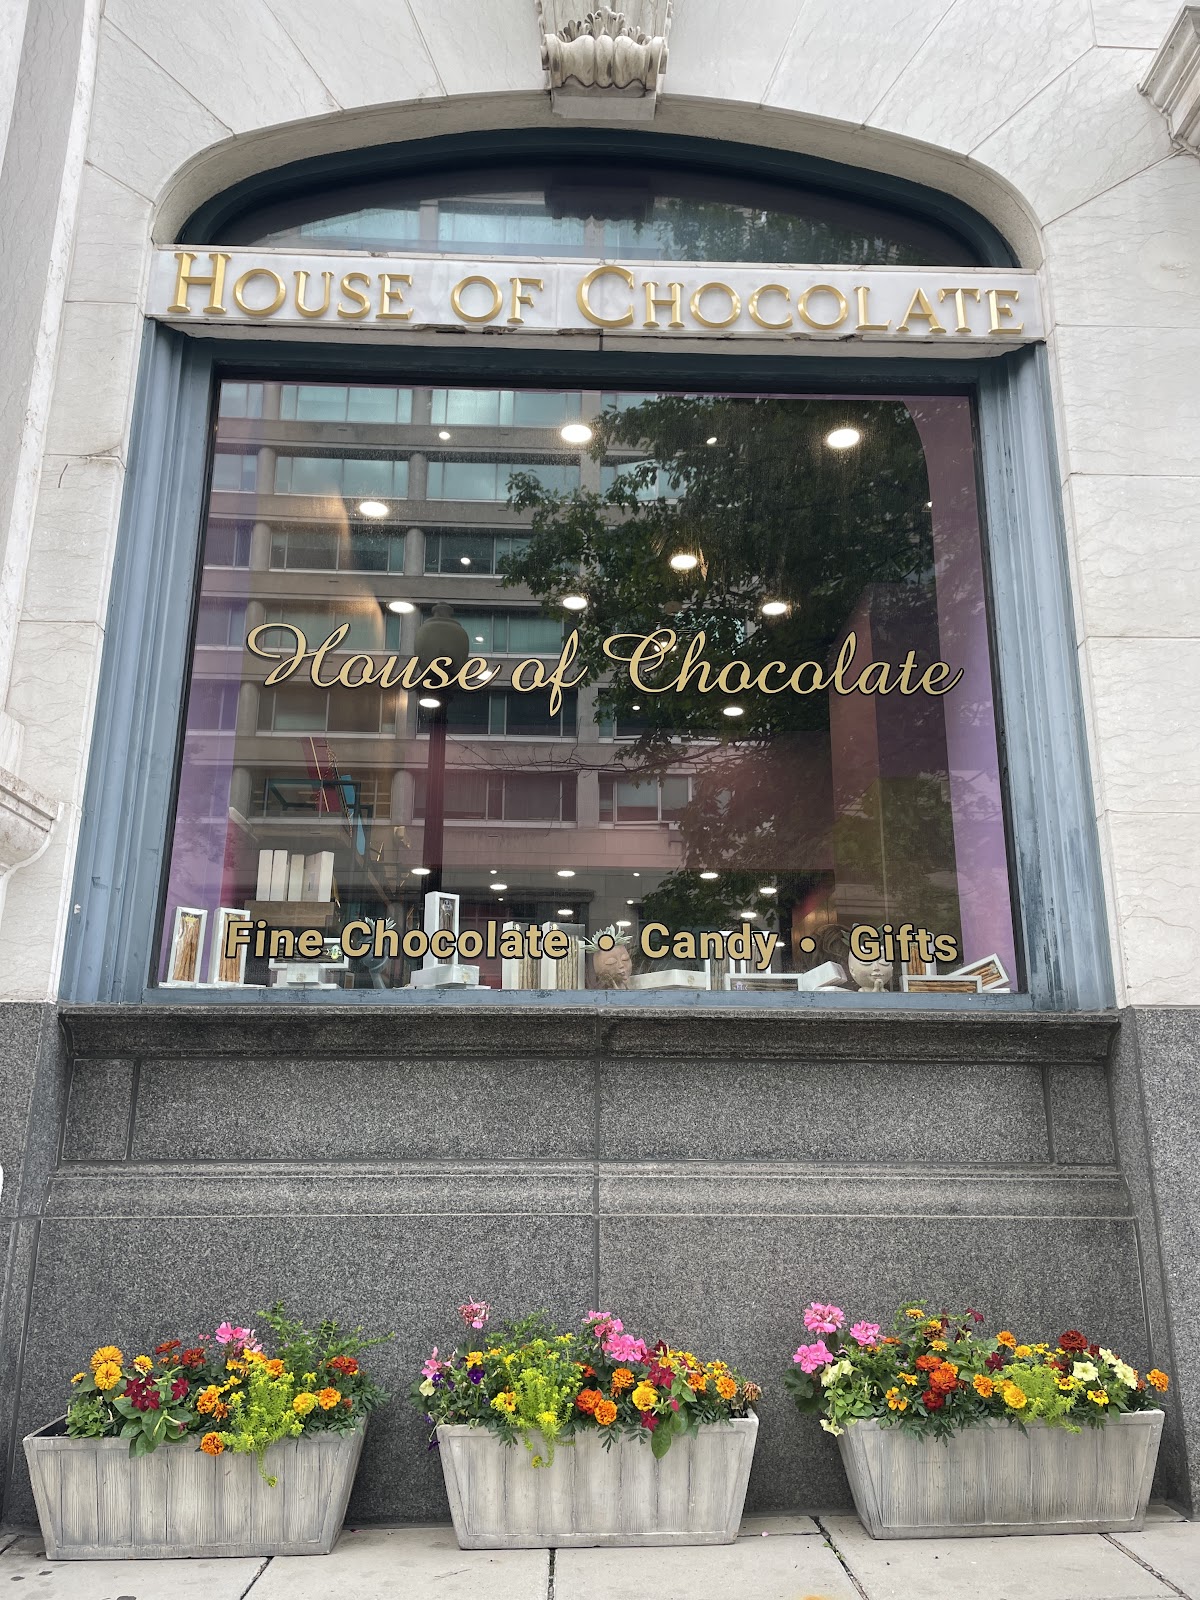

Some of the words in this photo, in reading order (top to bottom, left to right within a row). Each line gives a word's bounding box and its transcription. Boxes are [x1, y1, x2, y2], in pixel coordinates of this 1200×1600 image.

[167, 252, 414, 319] HOUSE
[451, 275, 545, 324] OF
[576, 265, 1024, 334] CHOCOLATE
[246, 622, 501, 692] House
[510, 628, 588, 717] of
[601, 627, 965, 696] Chocolate
[225, 919, 325, 959] Fine
[340, 920, 570, 960] Chocolate
[639, 922, 779, 970] Candy
[849, 924, 959, 964] Gifts
